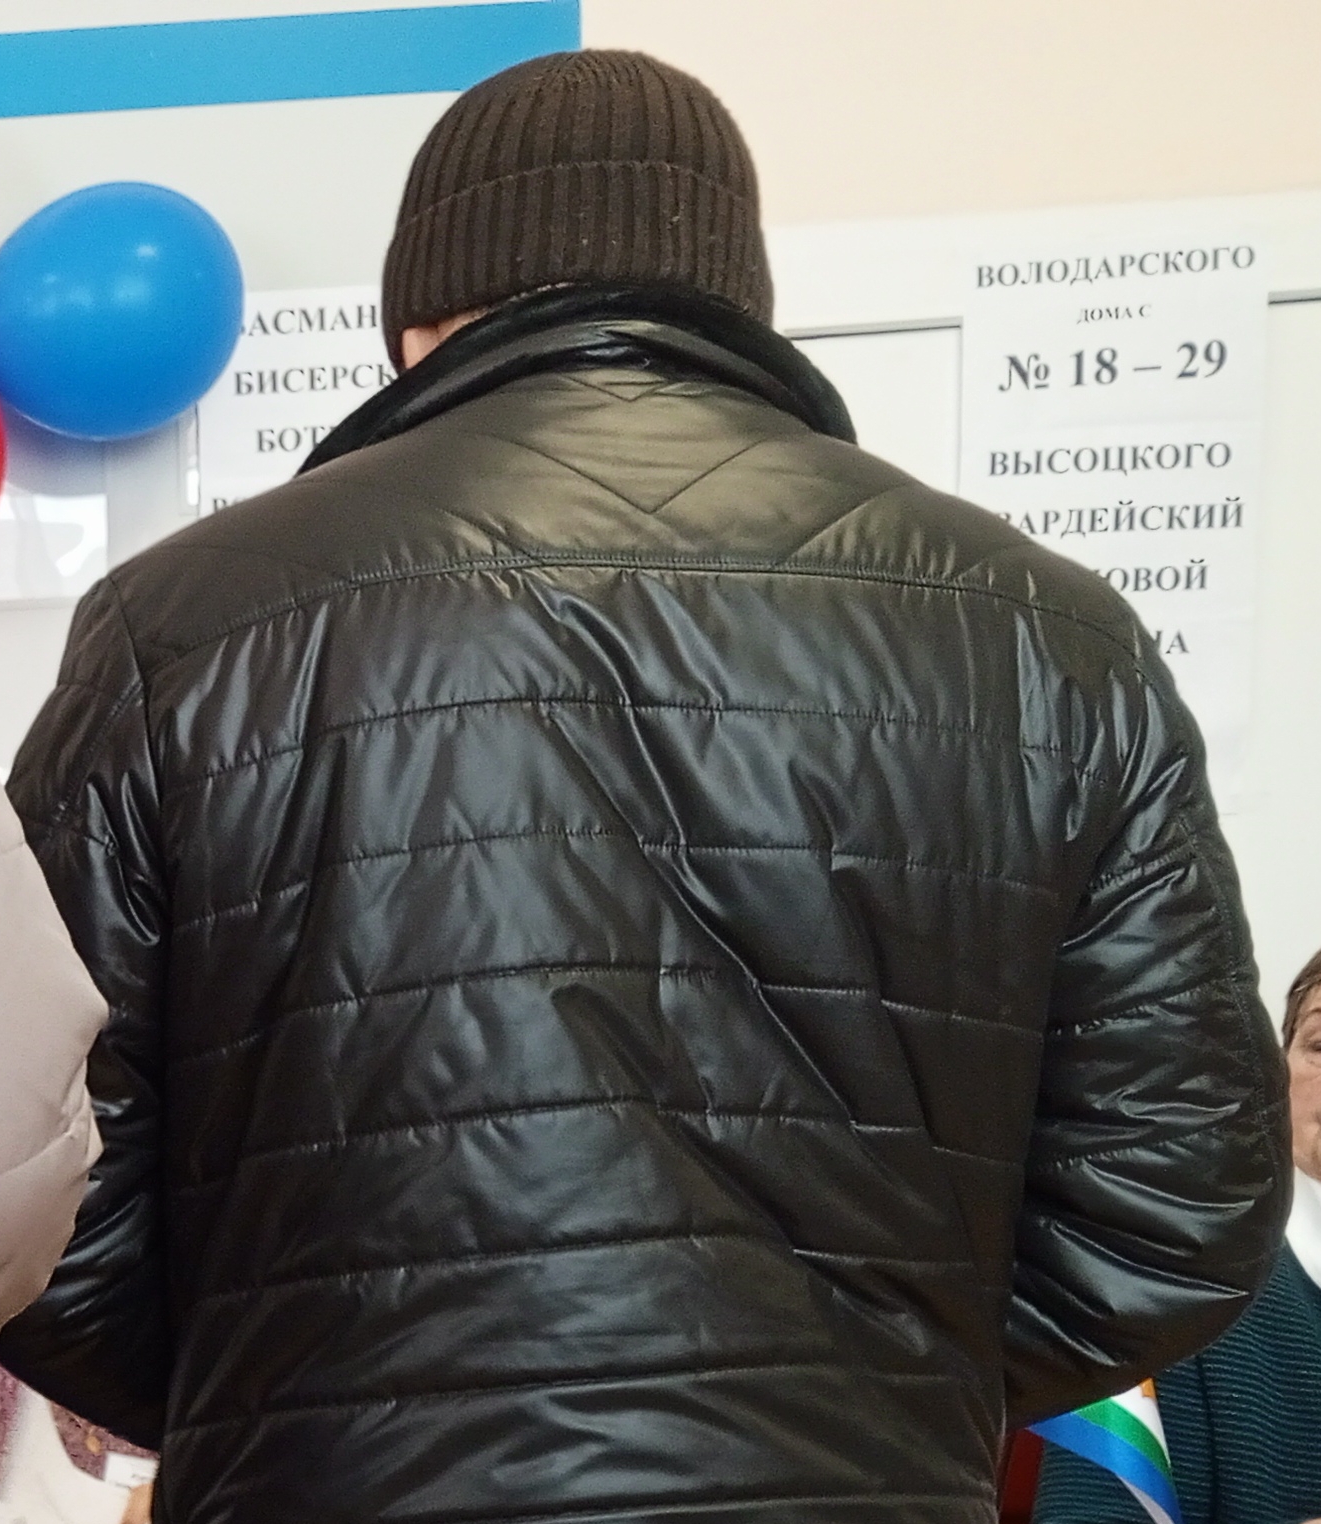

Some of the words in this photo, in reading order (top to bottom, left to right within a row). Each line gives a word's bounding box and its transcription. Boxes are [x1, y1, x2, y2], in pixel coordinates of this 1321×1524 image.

[976, 245, 1255, 288] ВОЛОДАРСКОГО
[240, 304, 378, 337] АСМАН
[1076, 306, 1133, 324] ДОМА
[998, 353, 1050, 392] №
[1069, 347, 1119, 388] 18
[1176, 339, 1229, 380] 29
[256, 425, 339, 453] БОТ
[988, 441, 1233, 476] ВЫСОЦКОГО
